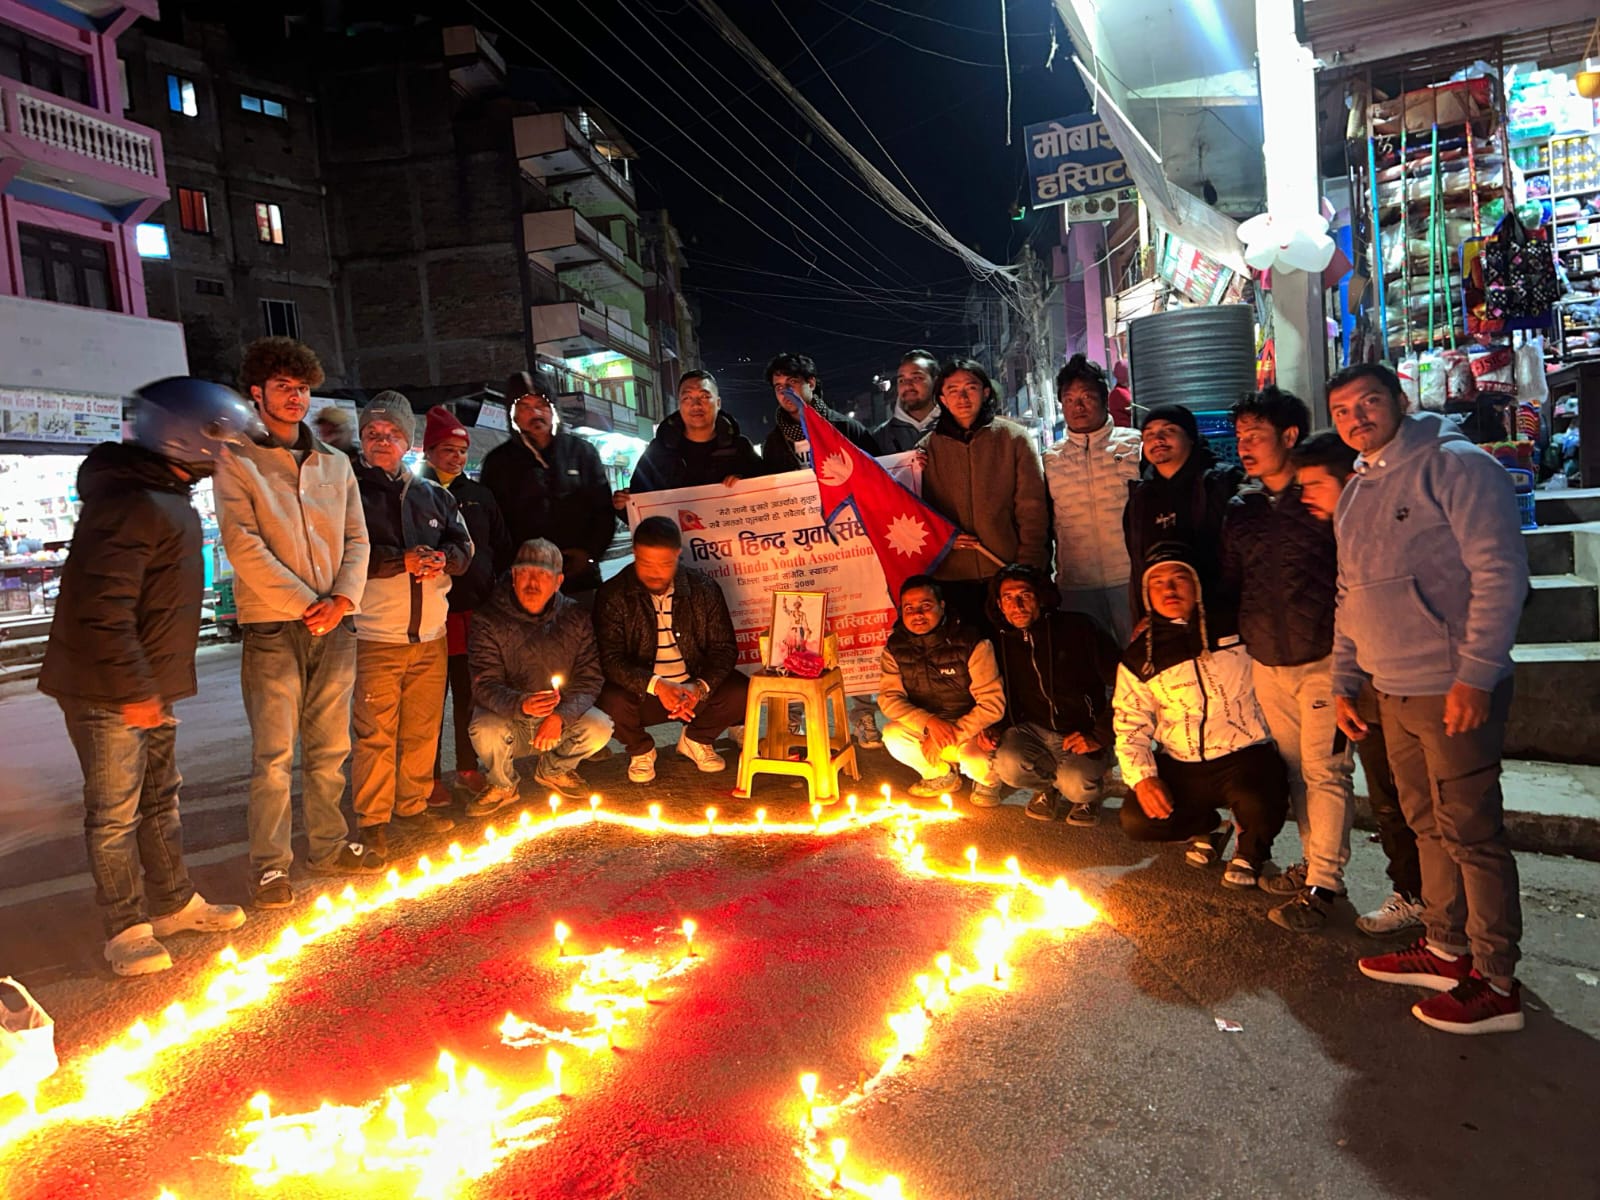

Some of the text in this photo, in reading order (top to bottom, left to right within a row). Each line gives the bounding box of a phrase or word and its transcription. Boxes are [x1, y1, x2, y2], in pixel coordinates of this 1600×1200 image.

[1033, 122, 1115, 158] मोबाइ
[690, 537, 733, 562] विश्व
[733, 560, 768, 576] Hindu
[771, 554, 805, 570] Youth
[810, 545, 874, 565] Association
